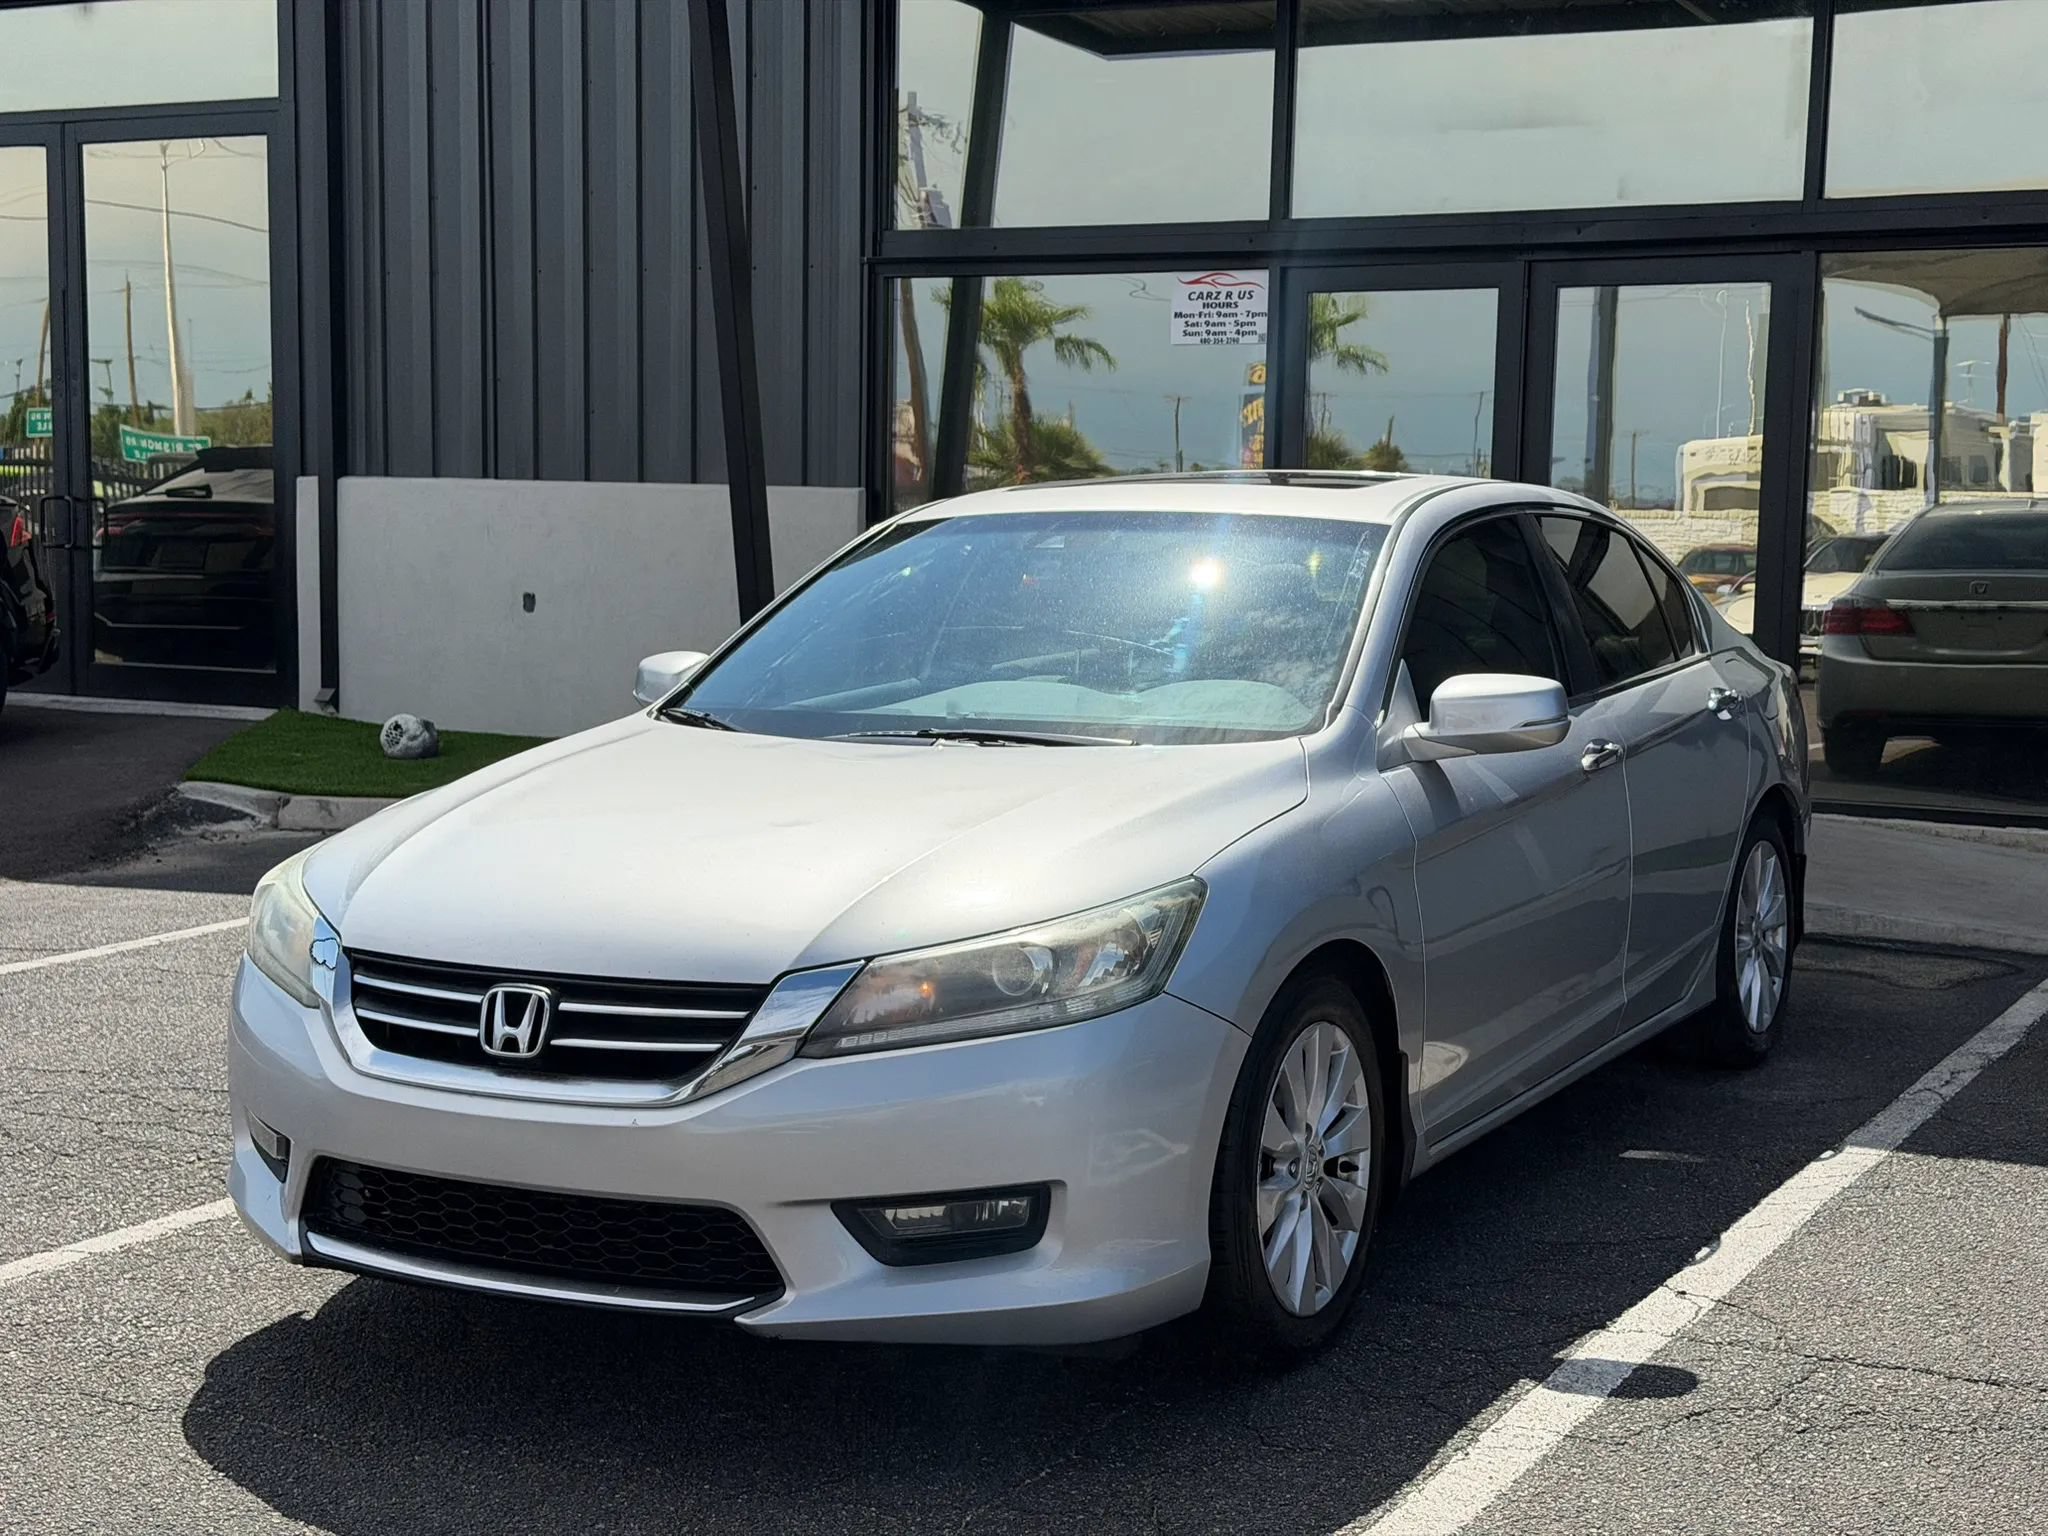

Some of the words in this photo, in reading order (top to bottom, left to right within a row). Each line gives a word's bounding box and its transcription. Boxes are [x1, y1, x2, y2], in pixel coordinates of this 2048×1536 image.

[1188, 291, 1222, 301] CARZ
[1224, 291, 1233, 301] R
[1237, 290, 1254, 300] US
[1202, 301, 1239, 309] HOURS
[1245, 311, 1268, 319] 7pm
[1184, 320, 1202, 328] Sat:
[1233, 320, 1256, 328] 5pm
[1182, 329, 1203, 337] Sun:
[1234, 329, 1257, 337] 4pm
